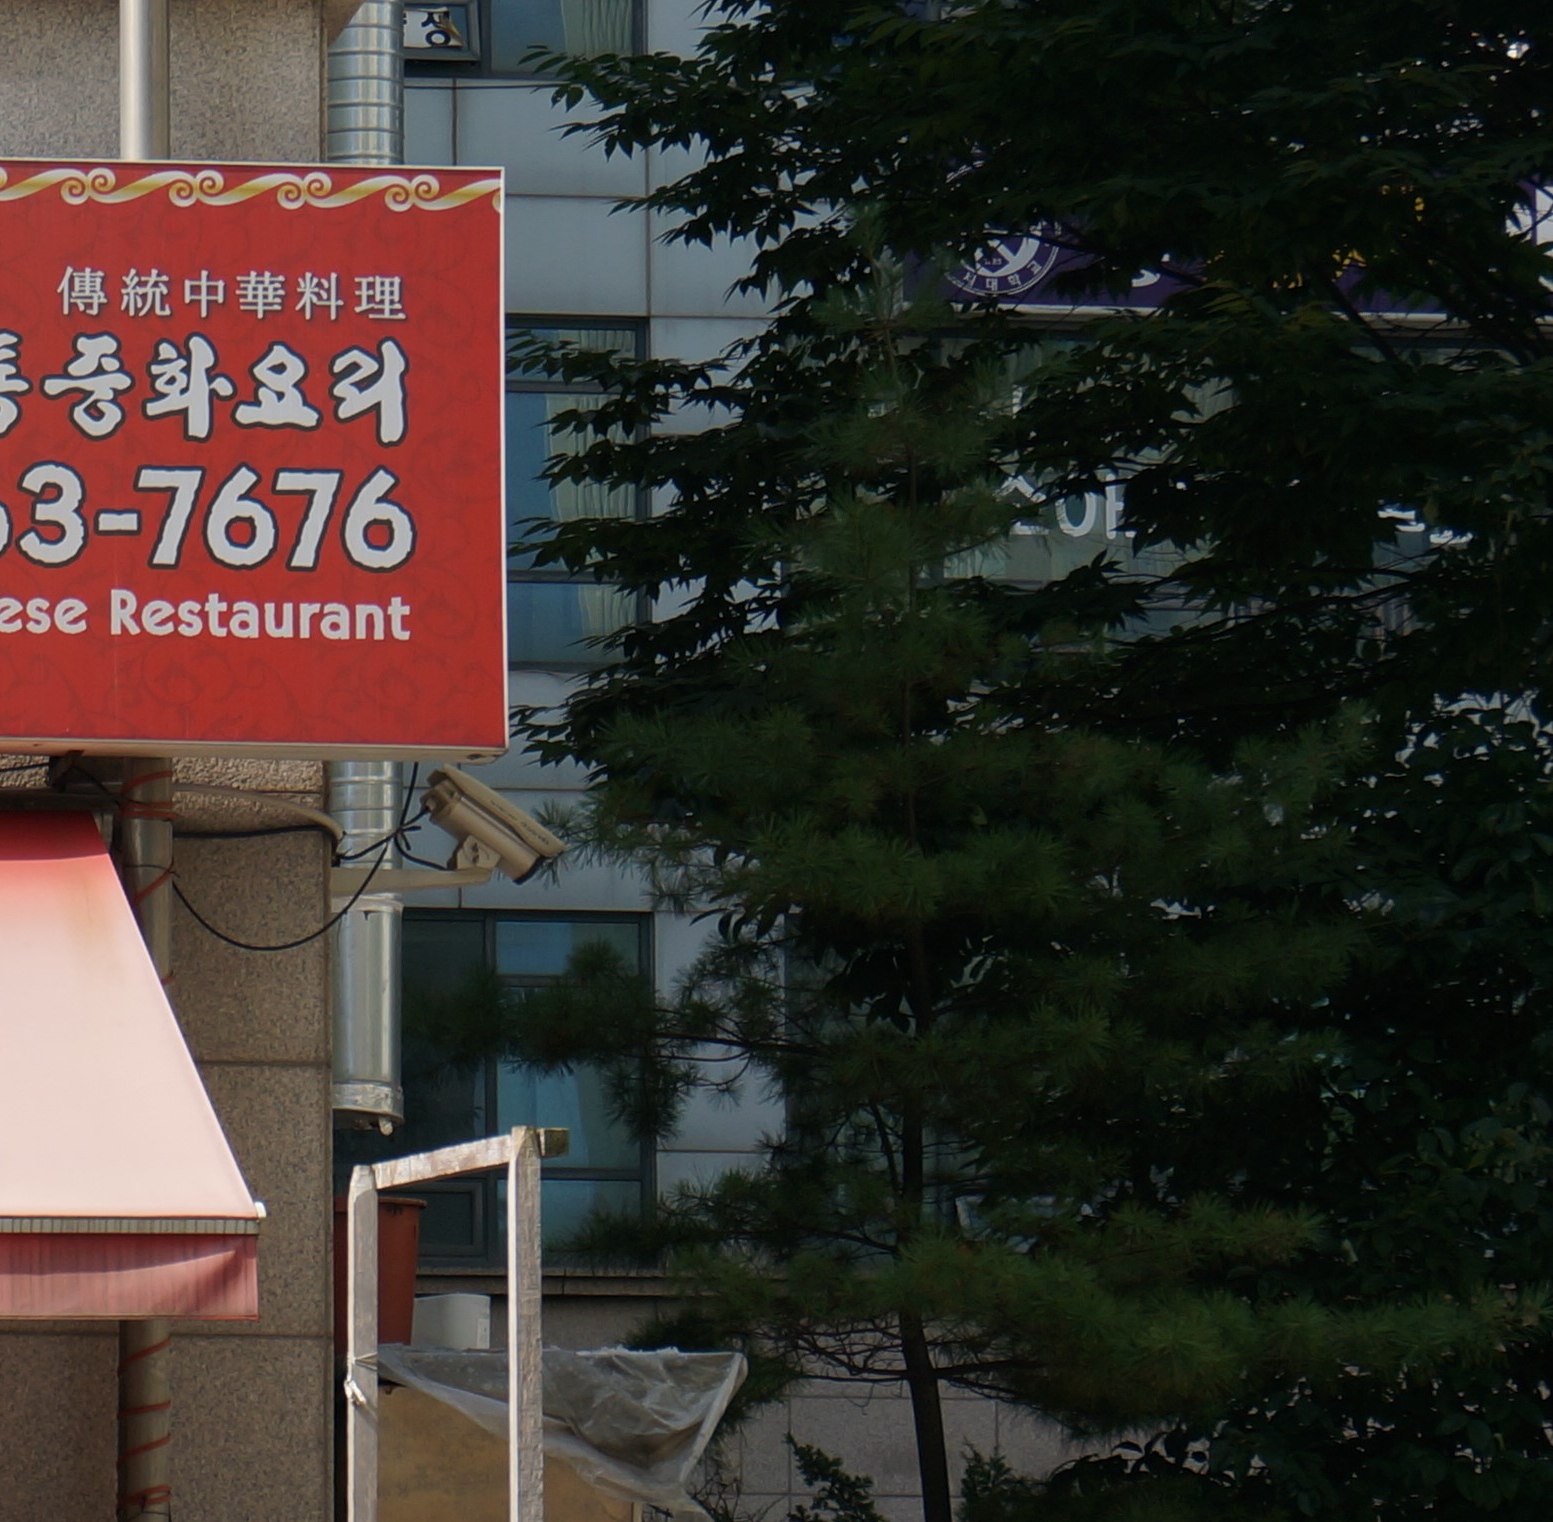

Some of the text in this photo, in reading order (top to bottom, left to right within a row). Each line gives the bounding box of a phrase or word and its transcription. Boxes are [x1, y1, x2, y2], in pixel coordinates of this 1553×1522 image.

[56, 265, 407, 321] 傳統中華料理
[110, 587, 411, 641] Restaurant
